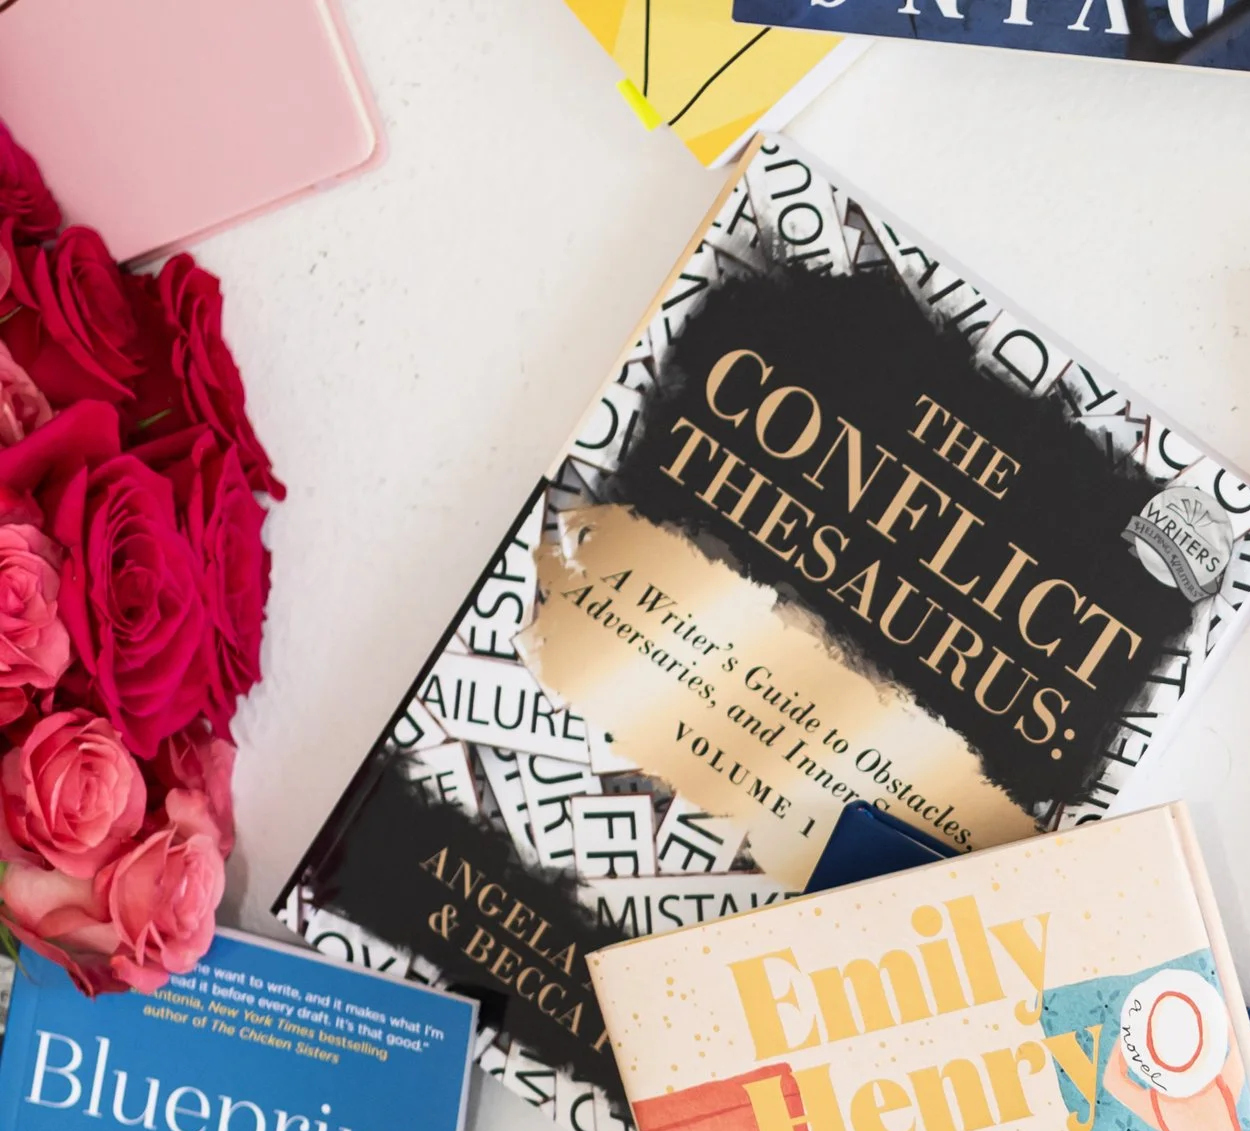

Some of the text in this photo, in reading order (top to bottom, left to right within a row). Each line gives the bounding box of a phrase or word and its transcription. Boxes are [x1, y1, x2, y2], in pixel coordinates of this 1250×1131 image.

[907, 394, 1022, 501] THE
[705, 348, 1143, 691] CONFLICT
[1134, 520, 1201, 599] HELPING WRITERS
[1147, 502, 1221, 573] WRITERS
[660, 416, 1076, 760] THESAURUS:
[560, 583, 860, 804] Adversaries, and Inner
[600, 568, 974, 852] A Writer's Guide to Obstacles,
[671, 719, 817, 839] VOLUME 1
[419, 846, 577, 976] ANGELA
[169, 974, 197, 992] ead
[198, 979, 209, 994] it
[211, 981, 256, 1006] before
[257, 994, 295, 1017] every
[297, 1003, 332, 1027] draft.
[335, 1013, 355, 1033] It's
[358, 1021, 384, 1041] that
[213, 966, 245, 986] want
[249, 974, 264, 989] to
[267, 979, 302, 1001] write,
[304, 989, 331, 1009] and
[333, 995, 344, 1011] it
[345, 1001, 387, 1024] makes
[389, 1013, 422, 1033] what
[424, 1023, 446, 1041] I'm
[428, 903, 461, 941] &
[462, 925, 584, 1038] BECCA
[725, 893, 1051, 1063] Emily
[143, 1004, 341, 1065] author of The Chicken Sisters
[208, 1000, 240, 1019] New
[243, 1009, 273, 1029] York
[276, 1017, 316, 1040] Times
[318, 1029, 389, 1061] bestselling
[1122, 1025, 1168, 1092] novel
